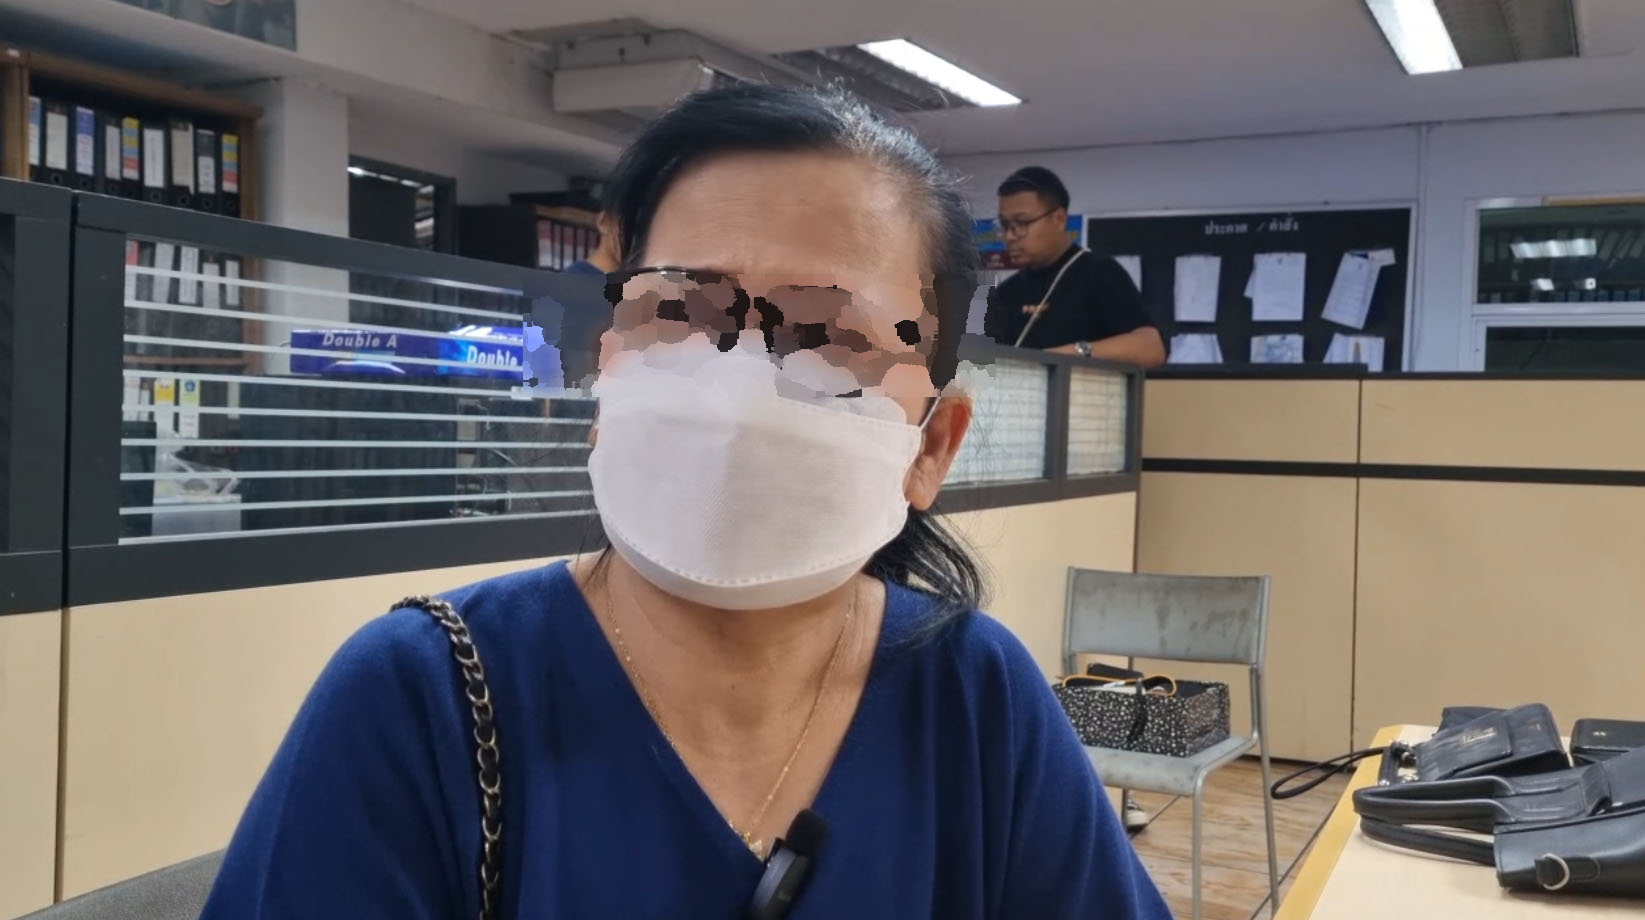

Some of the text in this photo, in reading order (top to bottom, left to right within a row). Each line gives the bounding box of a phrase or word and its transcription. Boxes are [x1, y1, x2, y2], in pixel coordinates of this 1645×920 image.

[322, 331, 397, 348] Double A
[467, 344, 518, 367] Double
